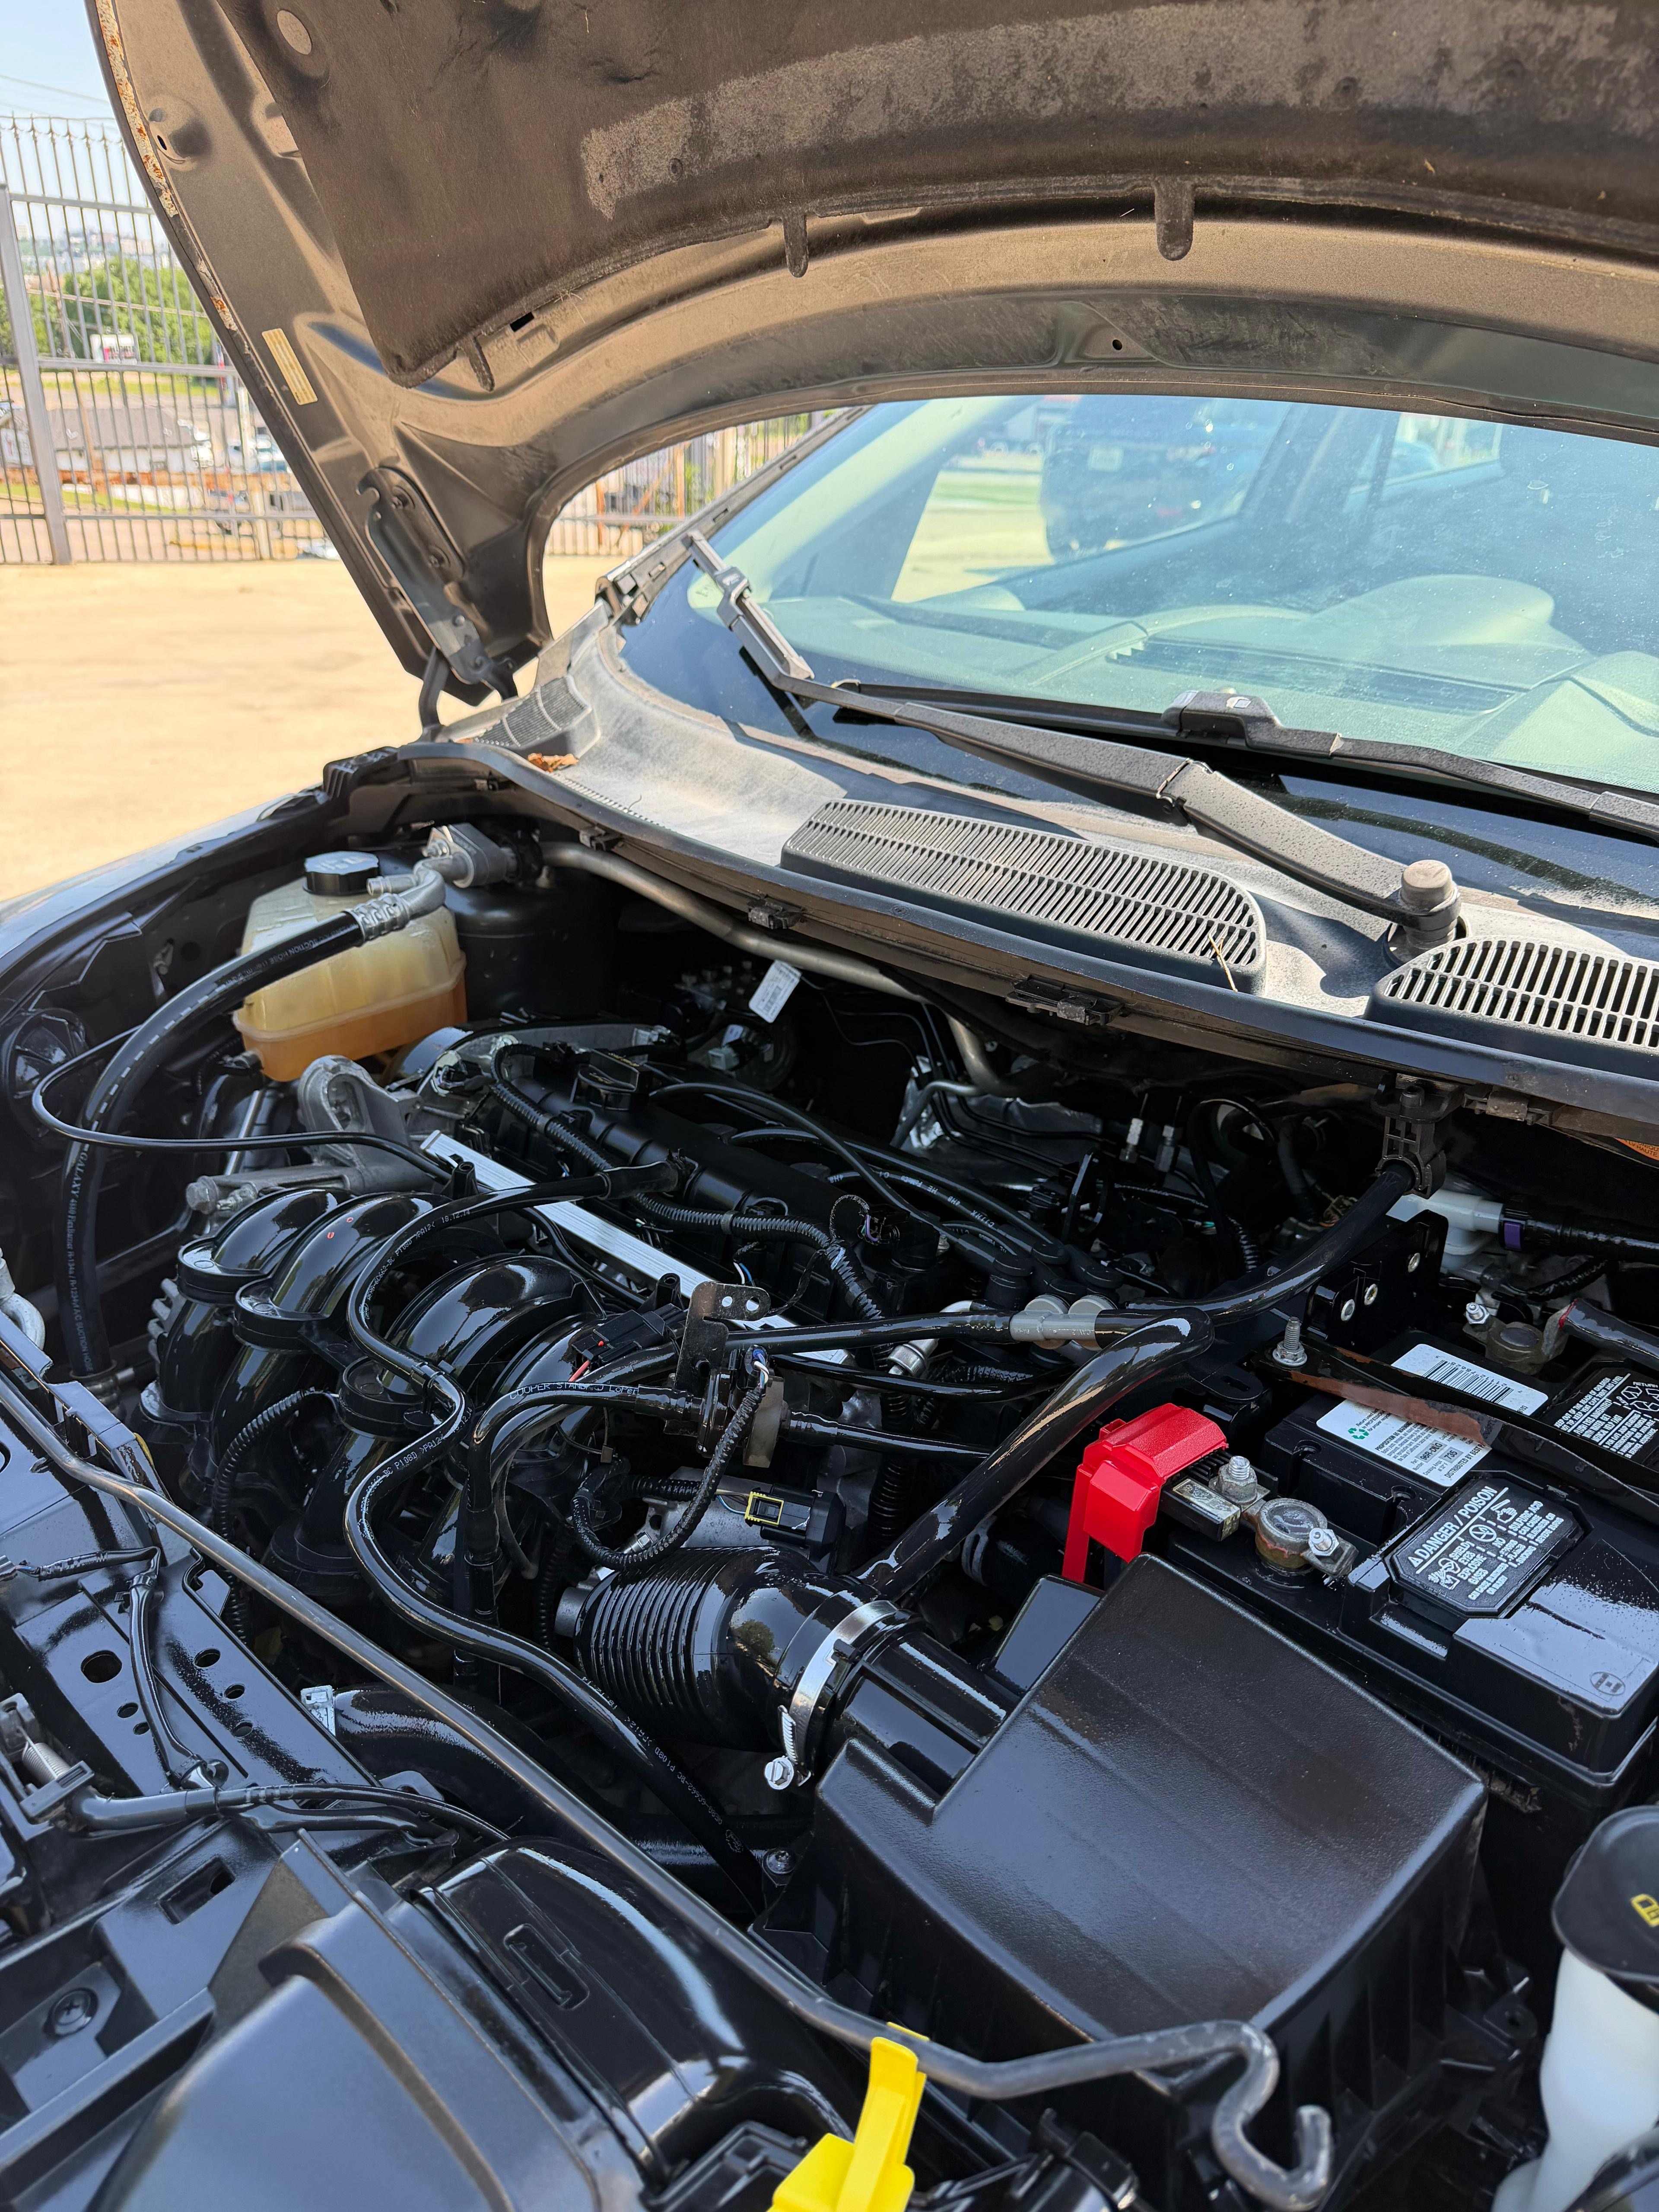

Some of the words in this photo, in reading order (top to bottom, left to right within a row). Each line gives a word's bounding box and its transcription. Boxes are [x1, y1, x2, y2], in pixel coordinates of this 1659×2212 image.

[70, 1152, 89, 1198] GALAXY
[76, 1322, 89, 1352] SUCTION
[1375, 1435, 1395, 1450] PROPOSITION
[1397, 1421, 1413, 1432] WARNING
[1444, 1450, 1457, 1459] 735
[1444, 1458, 1468, 1478] DISTRIBUTED
[1470, 1446, 1481, 1455] BEST
[1415, 1522, 1459, 1558] DANGER
[1458, 1487, 1497, 1518] POISON
[1509, 1510, 1533, 1531] SULFURIC
[1528, 1501, 1543, 1513] ACID
[1519, 1526, 1530, 1535] CAN
[1526, 1515, 1542, 1527] CAUSE
[1527, 1519, 1549, 1539] BLINDNESS
[1492, 1538, 1506, 1548] NO
[1535, 1529, 1552, 1543] SEVERE
[1548, 1517, 1564, 1530] BURNS
[1449, 1542, 1470, 1560] SHIELD
[1459, 1551, 1475, 1565] EYES
[1458, 1554, 1486, 1580] EXPLOSIVE
[1468, 1568, 1488, 1584] GASES
[1468, 1591, 1480, 1600] CAN
[1475, 1580, 1491, 1592] CAUSE
[1486, 1563, 1508, 1582] BLINDNESS
